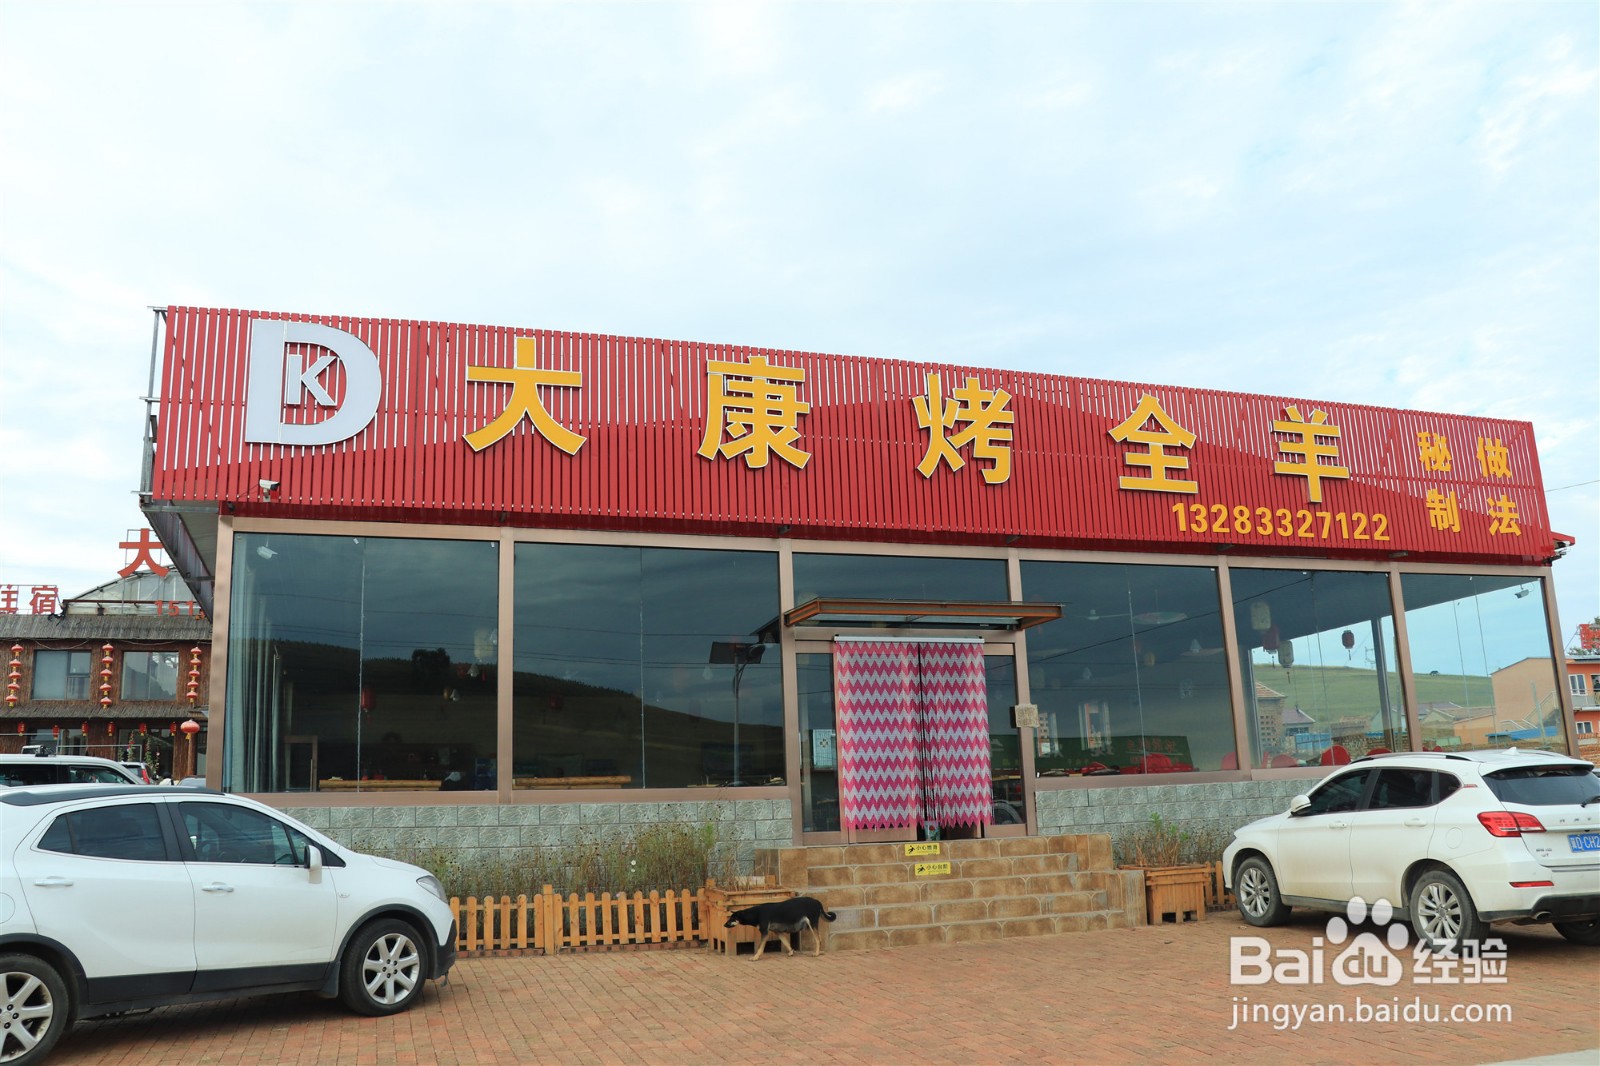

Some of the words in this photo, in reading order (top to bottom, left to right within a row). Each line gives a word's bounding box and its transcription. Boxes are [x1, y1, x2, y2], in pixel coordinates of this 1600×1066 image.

[464, 336, 1350, 504] 大康烤全羊
[1171, 501, 1391, 543] 13283327122
